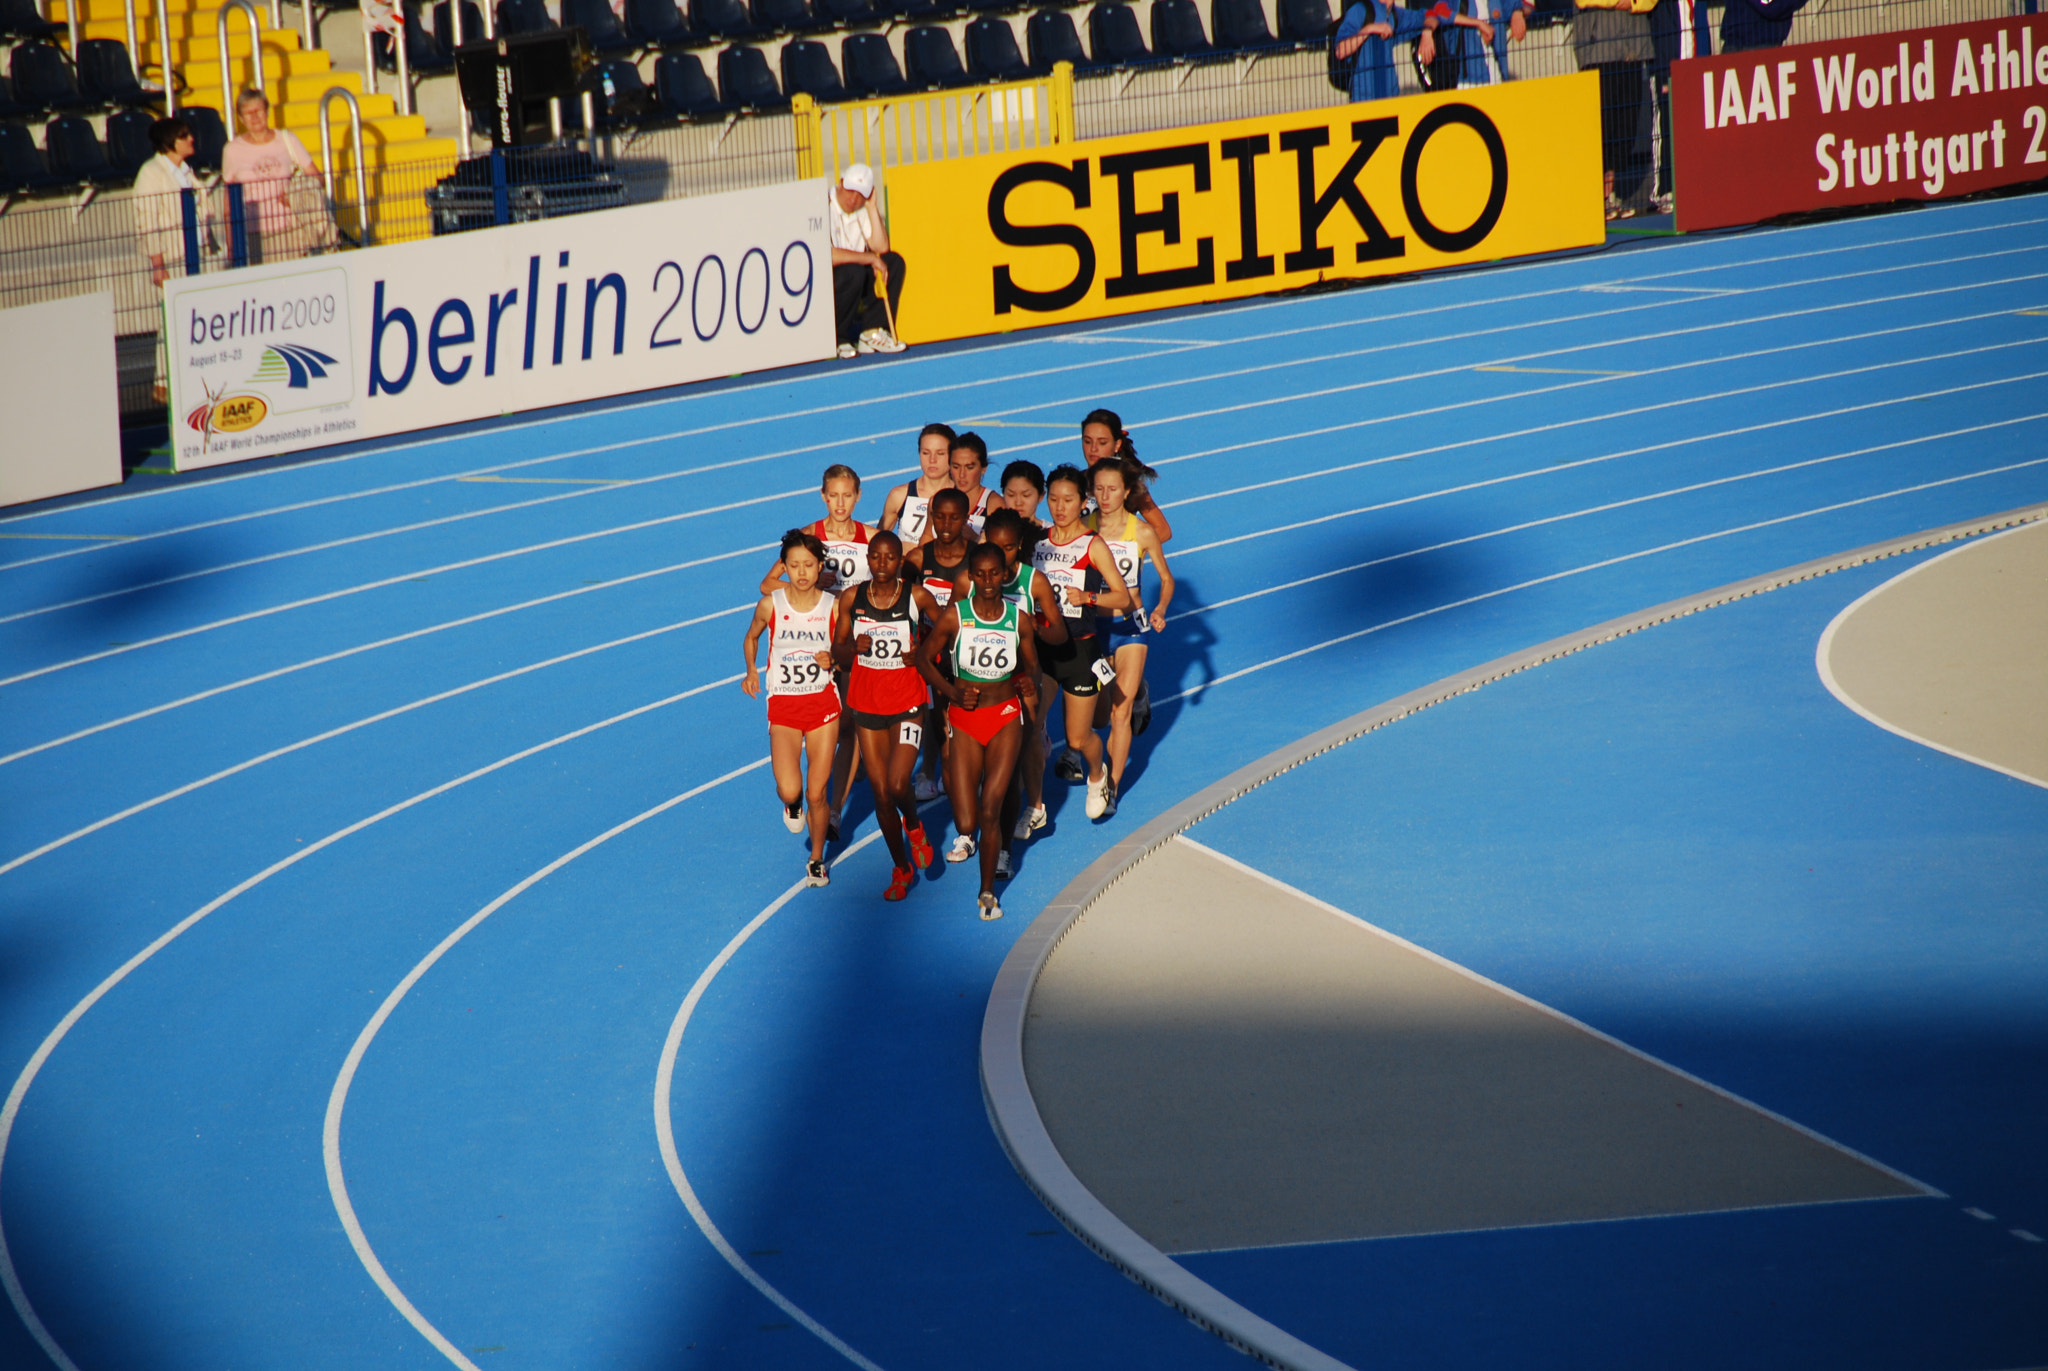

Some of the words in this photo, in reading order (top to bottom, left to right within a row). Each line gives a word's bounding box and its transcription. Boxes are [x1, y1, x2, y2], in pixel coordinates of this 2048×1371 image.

[1703, 61, 1796, 129] IAAF
[1813, 39, 1935, 114] World
[1815, 119, 2005, 194] Stuttgart
[2024, 106, 2047, 164] 2
[988, 103, 1508, 315] SEIKO
[808, 217, 822, 232] TM
[191, 298, 274, 345] berlin
[281, 294, 335, 330] 2009
[368, 250, 627, 397] berlin
[650, 240, 813, 349] 2009
[190, 354, 217, 367] August
[222, 402, 254, 418] IAAF
[211, 440, 228, 453] IAAF
[231, 434, 252, 448] World
[255, 427, 312, 446] Championships
[314, 424, 321, 434] in
[324, 420, 356, 433] Athletics
[1036, 551, 1078, 563] KOREA
[778, 630, 825, 641] JAPAN
[969, 646, 1008, 669] 166
[780, 663, 820, 684] 359
[1100, 662, 1111, 675] 4
[902, 727, 919, 744] 11
